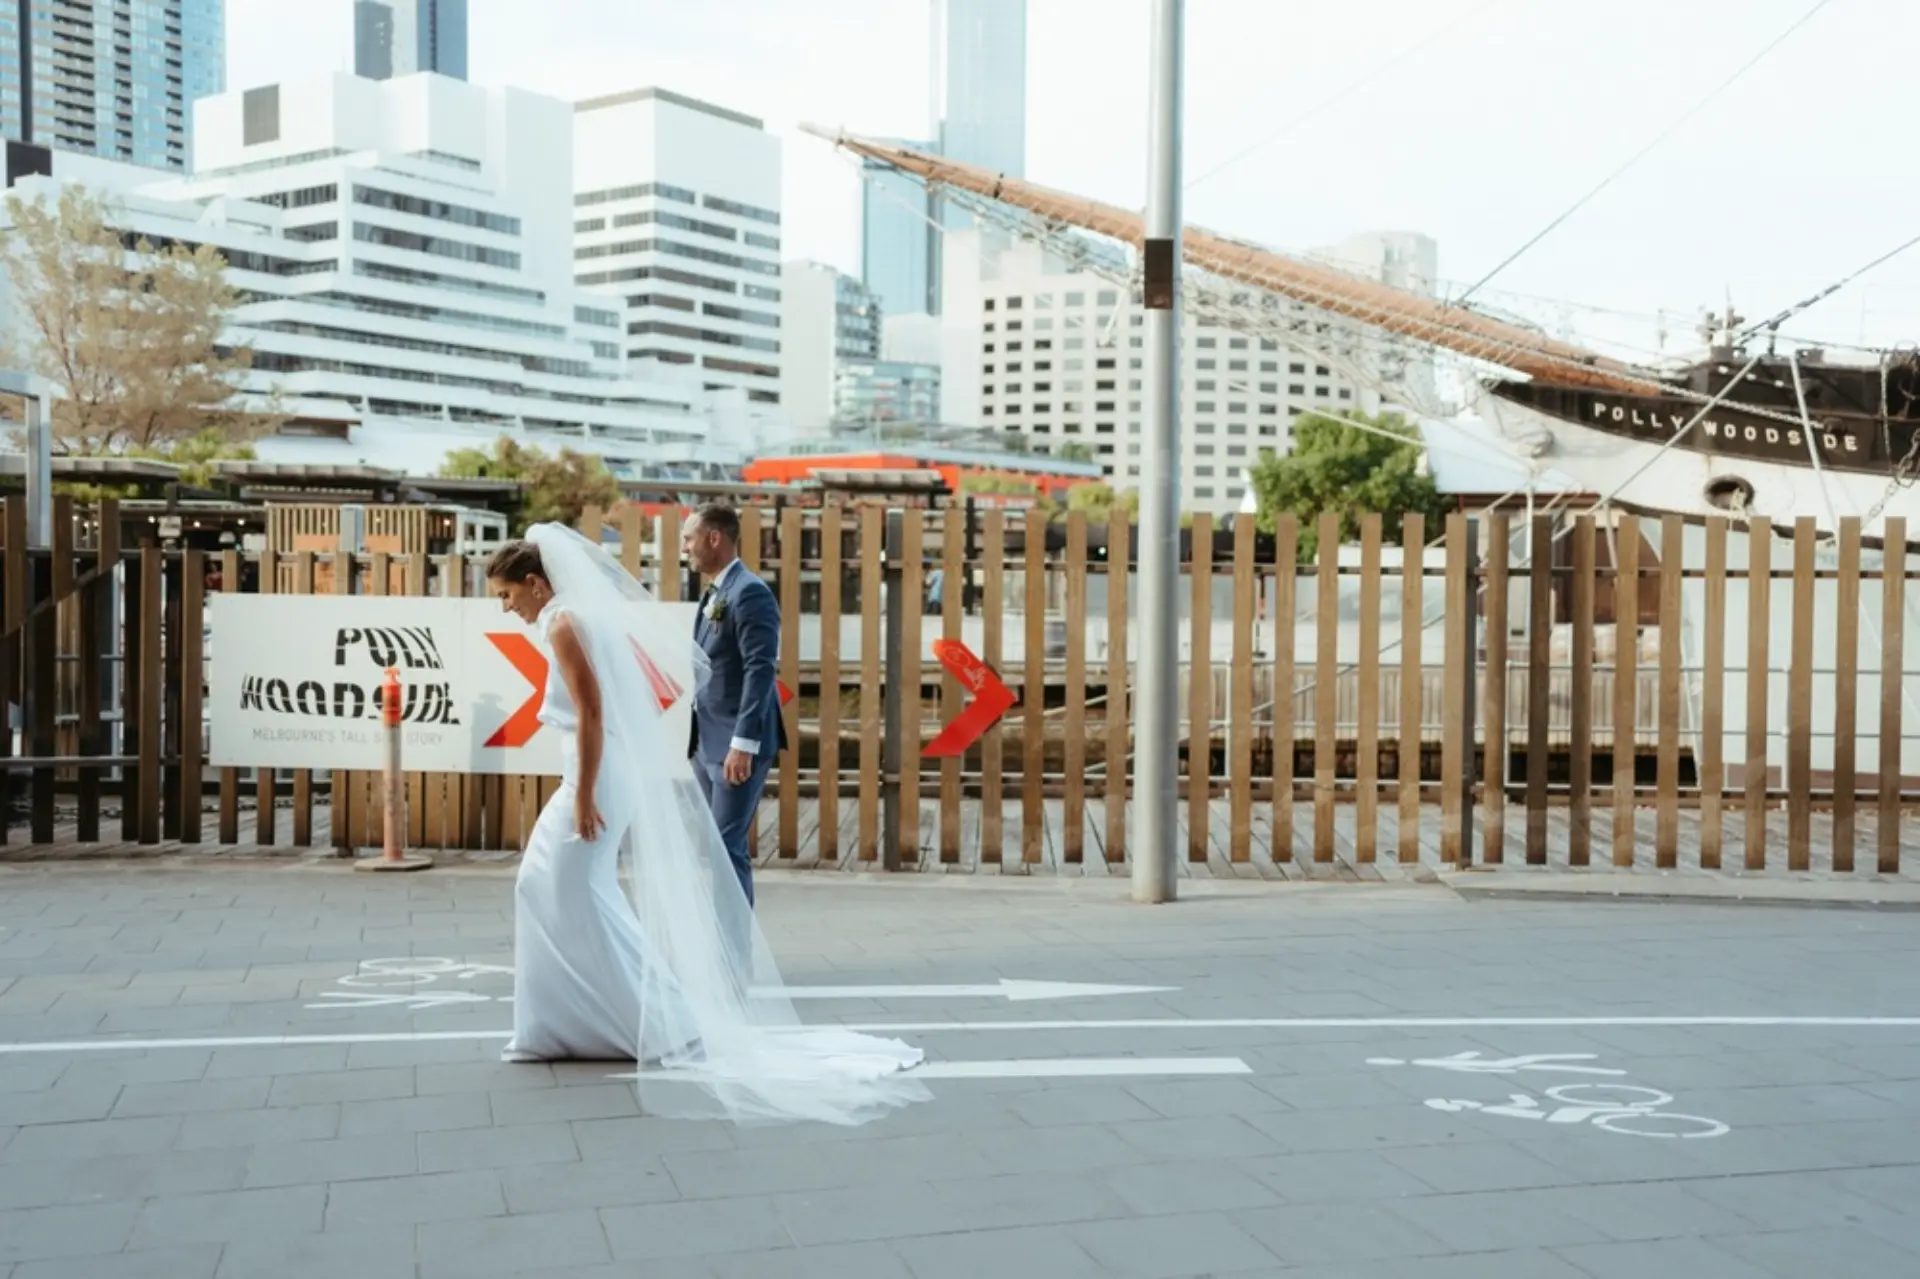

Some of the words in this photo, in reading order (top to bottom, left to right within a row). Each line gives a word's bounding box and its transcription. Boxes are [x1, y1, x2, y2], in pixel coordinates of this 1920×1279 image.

[1594, 402, 1684, 431] POLLY
[1702, 420, 1858, 451] WOODSDE
[334, 626, 445, 670] POLLY
[252, 728, 336, 744] MELBOURNE'S
[341, 730, 368, 744] TALL
[406, 732, 444, 746] STORY
